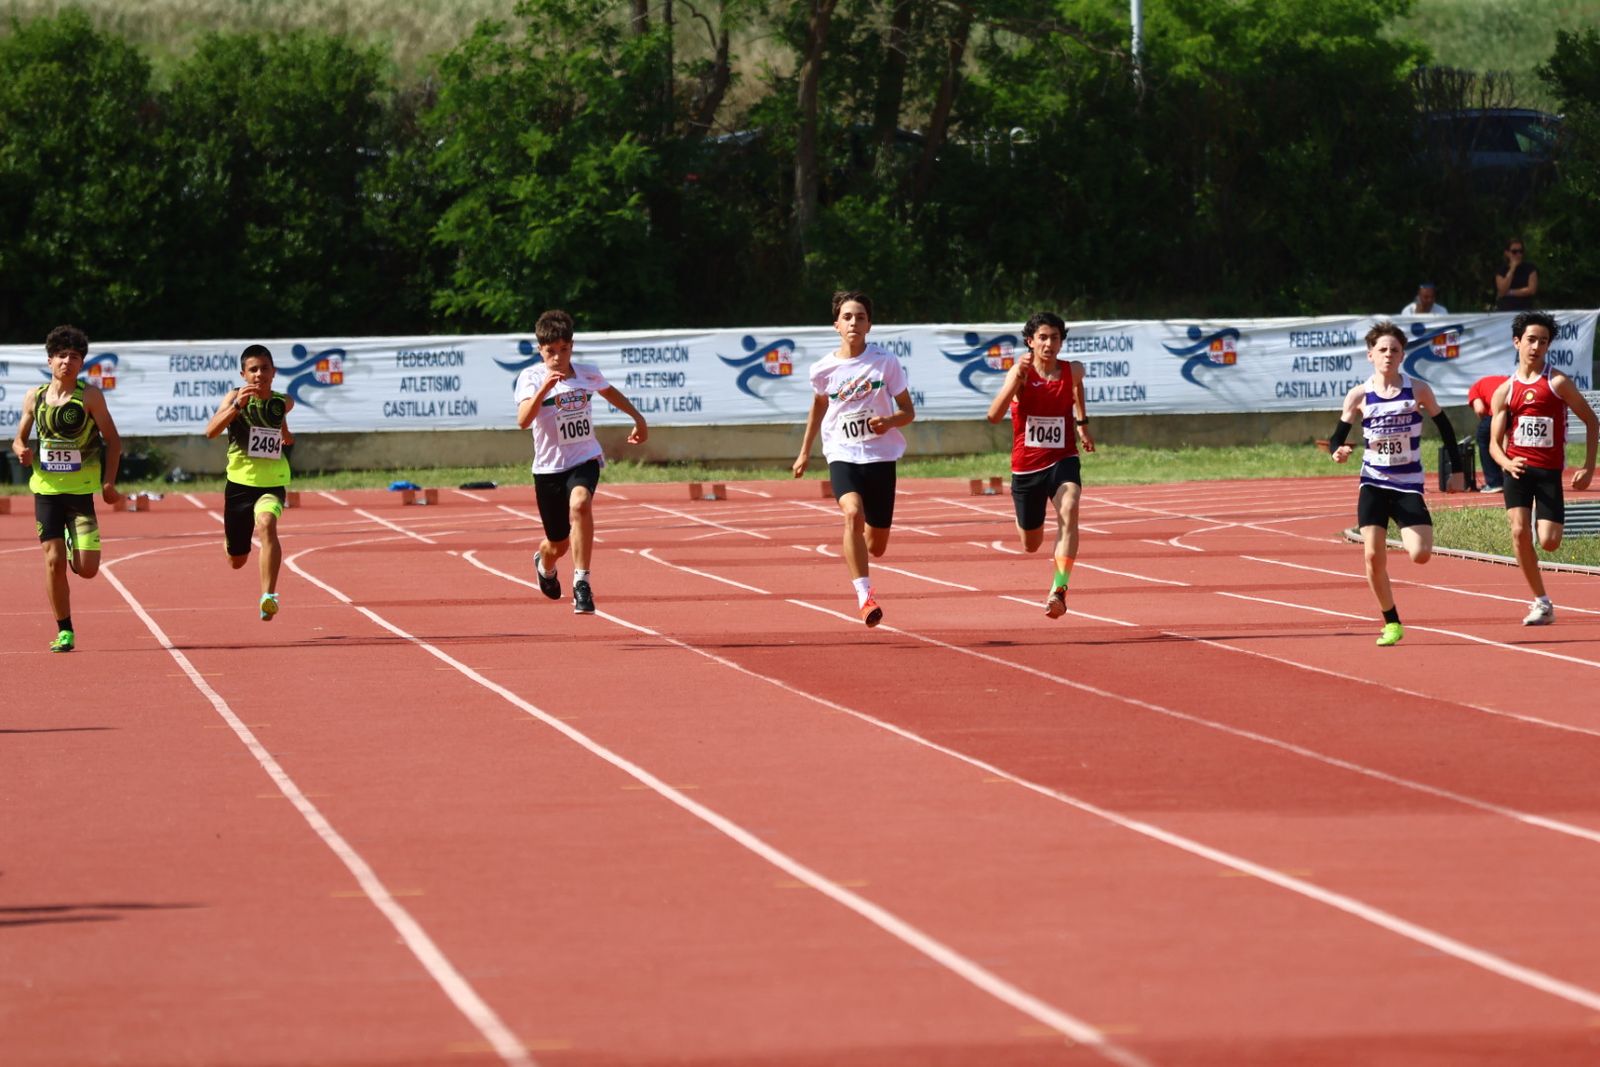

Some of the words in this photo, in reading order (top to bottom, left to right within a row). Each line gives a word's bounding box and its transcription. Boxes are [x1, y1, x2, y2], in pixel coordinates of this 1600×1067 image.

[1066, 331, 1133, 352] FEDERACIÓN
[1289, 326, 1357, 348] FEDERACIÓN
[169, 351, 238, 372] FEDERACIÓN
[621, 343, 689, 363] FEDERACIÓN
[1291, 355, 1353, 373] ATLETISMO
[400, 375, 461, 392] ATLETISMO
[625, 372, 685, 388] ATLETISMO
[1275, 380, 1328, 398] CASTILLA
[1329, 379, 1337, 397] Y
[1108, 385, 1115, 402] Y
[1117, 381, 1146, 402] LEÓN
[383, 401, 436, 417] CASTILLA
[438, 400, 446, 416] Y
[448, 396, 478, 416] LEÓN
[662, 397, 670, 412] Y
[673, 392, 702, 412] LEÓN
[156, 405, 210, 422] CASTILLA
[560, 419, 590, 440] 1069
[1029, 425, 1061, 443] 1049
[1520, 422, 1548, 437] 1652
[251, 435, 281, 454] 2494
[1376, 441, 1402, 455] 2693
[47, 450, 72, 462] 515
